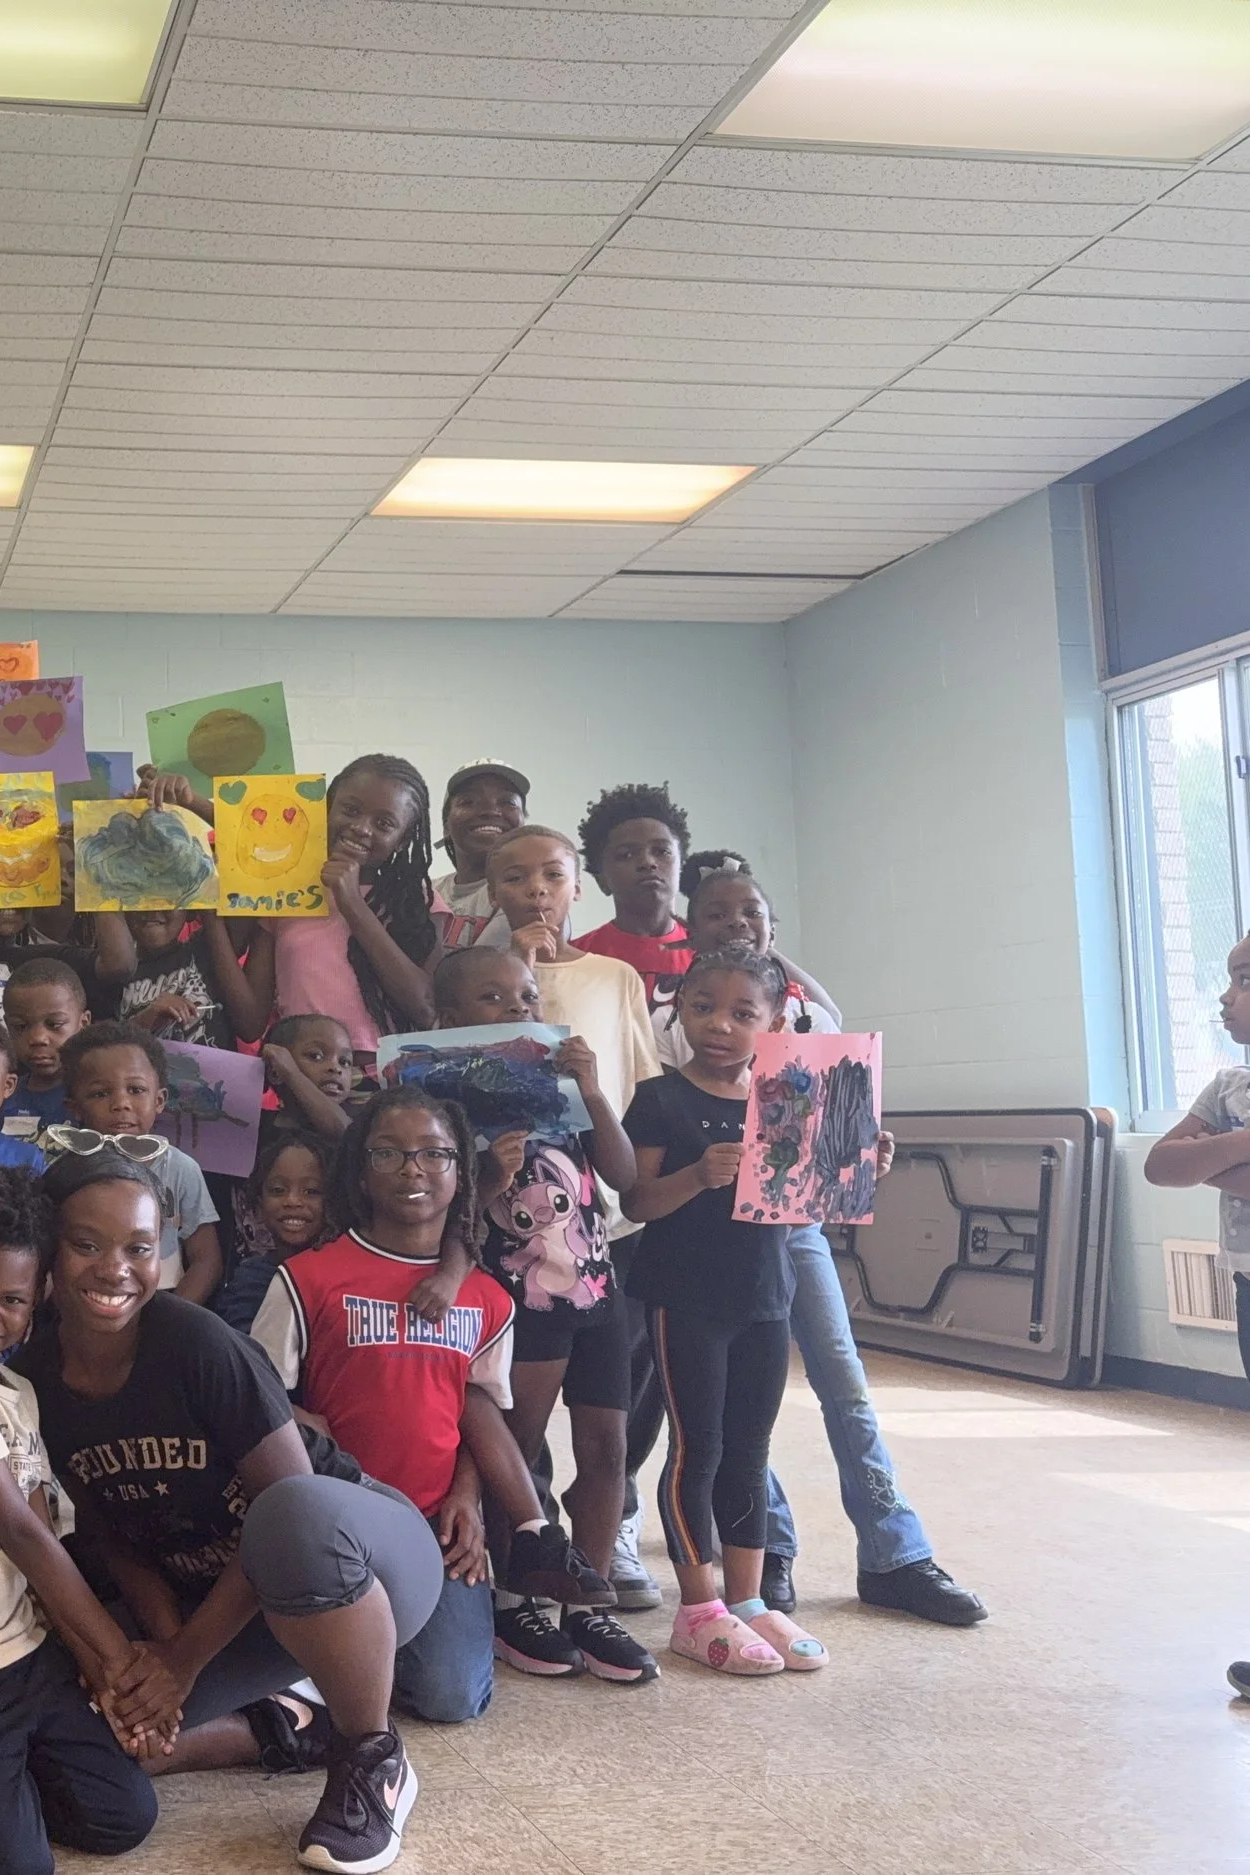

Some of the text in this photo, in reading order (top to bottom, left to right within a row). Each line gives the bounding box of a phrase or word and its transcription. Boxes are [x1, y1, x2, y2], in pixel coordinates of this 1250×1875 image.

[343, 1294, 484, 1358] TRUE RELIGION
[67, 1436, 207, 1485] FOUNDED
[118, 1483, 150, 1501] USA
